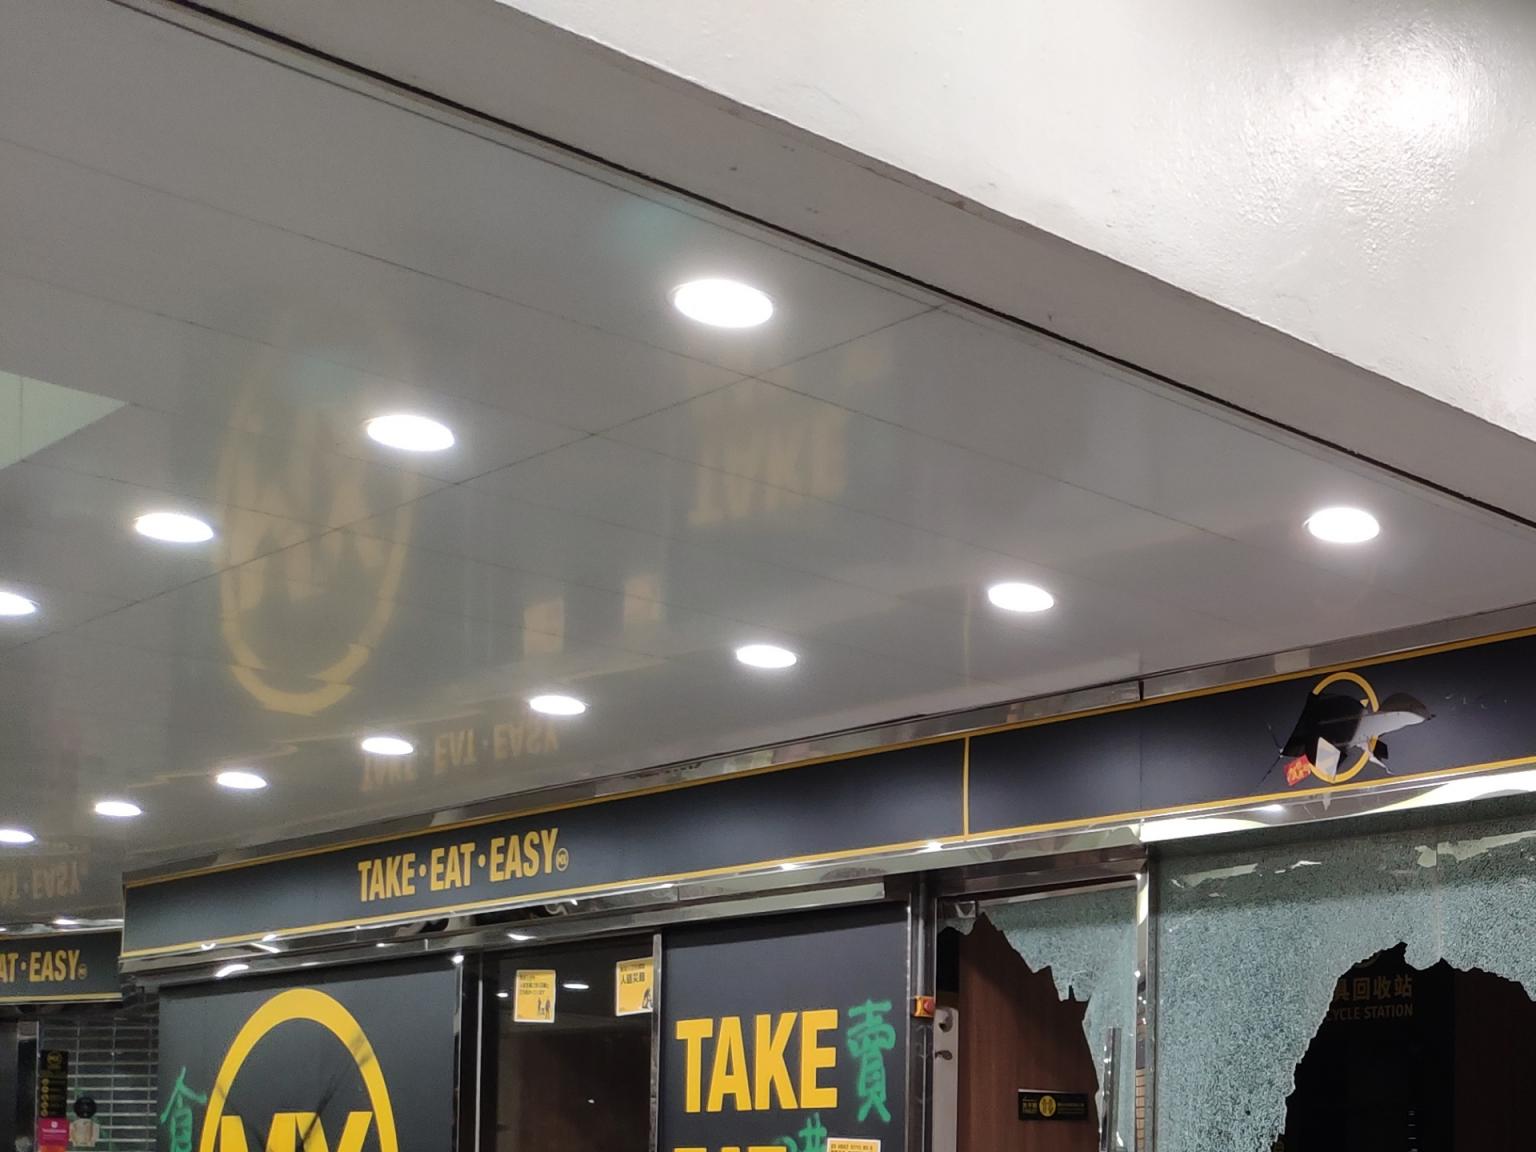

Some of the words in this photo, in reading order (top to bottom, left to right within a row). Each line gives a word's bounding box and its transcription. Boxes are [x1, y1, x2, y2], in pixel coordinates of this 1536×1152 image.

[358, 852, 416, 902] TAKE
[430, 842, 476, 891] EAT
[490, 828, 559, 882] EASY
[29, 949, 80, 982] EASY
[1364, 1002, 1414, 1019] STATION
[675, 1009, 838, 1113] TAKE
